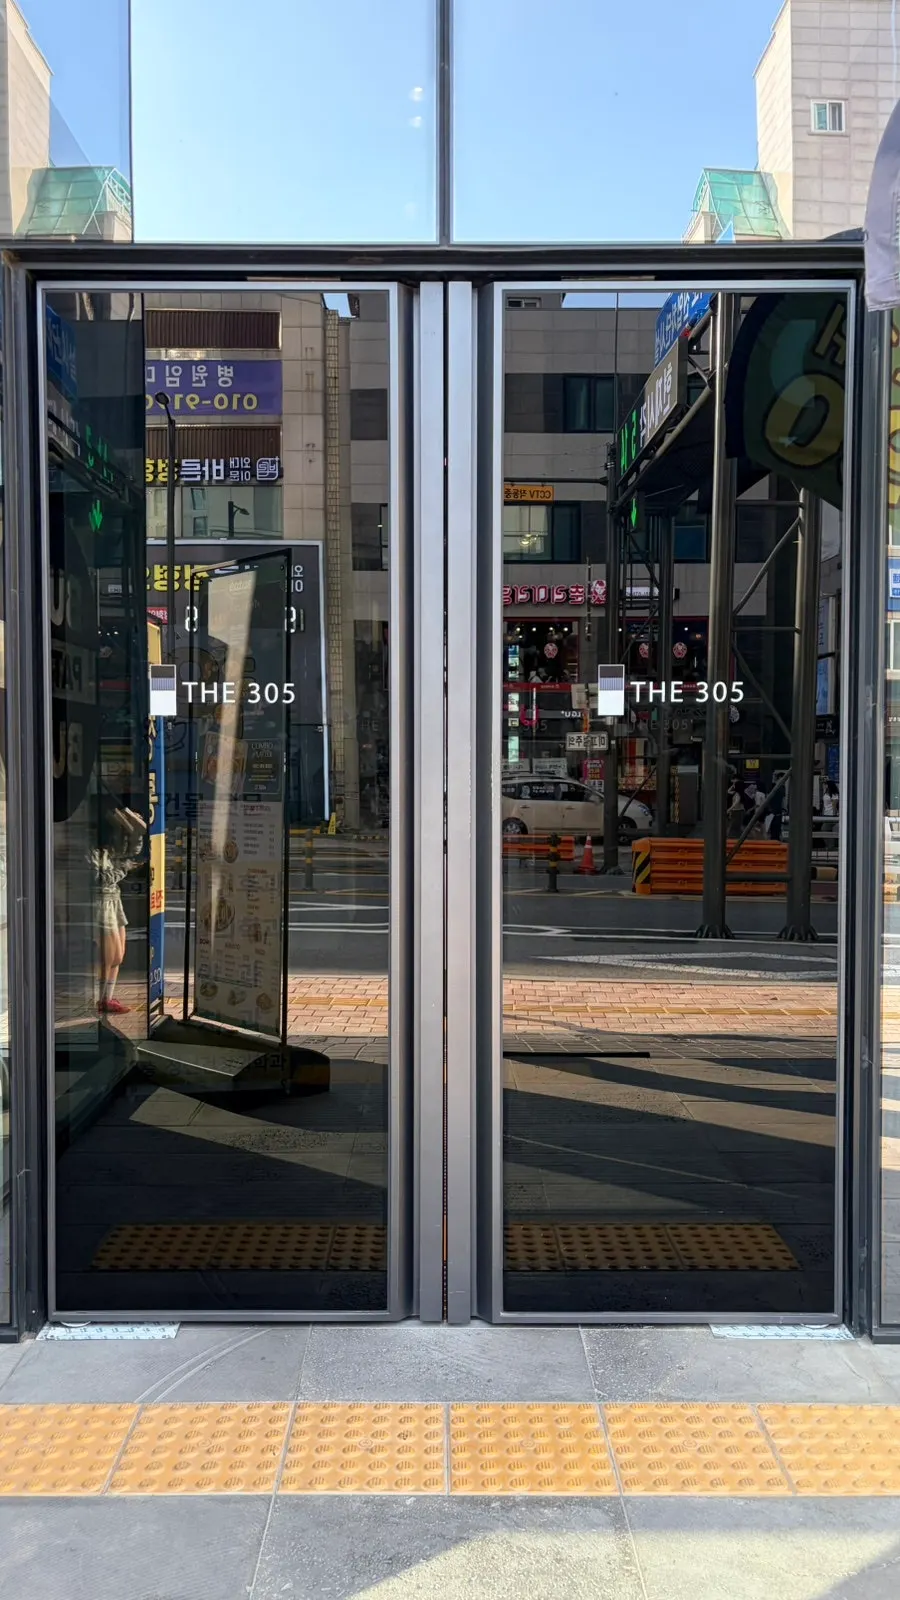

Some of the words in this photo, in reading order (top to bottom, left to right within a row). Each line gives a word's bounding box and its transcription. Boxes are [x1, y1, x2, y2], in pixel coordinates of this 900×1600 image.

[182, 682, 236, 704] THE
[247, 682, 296, 704] 305
[630, 681, 684, 703] THE
[695, 681, 745, 703] 305
